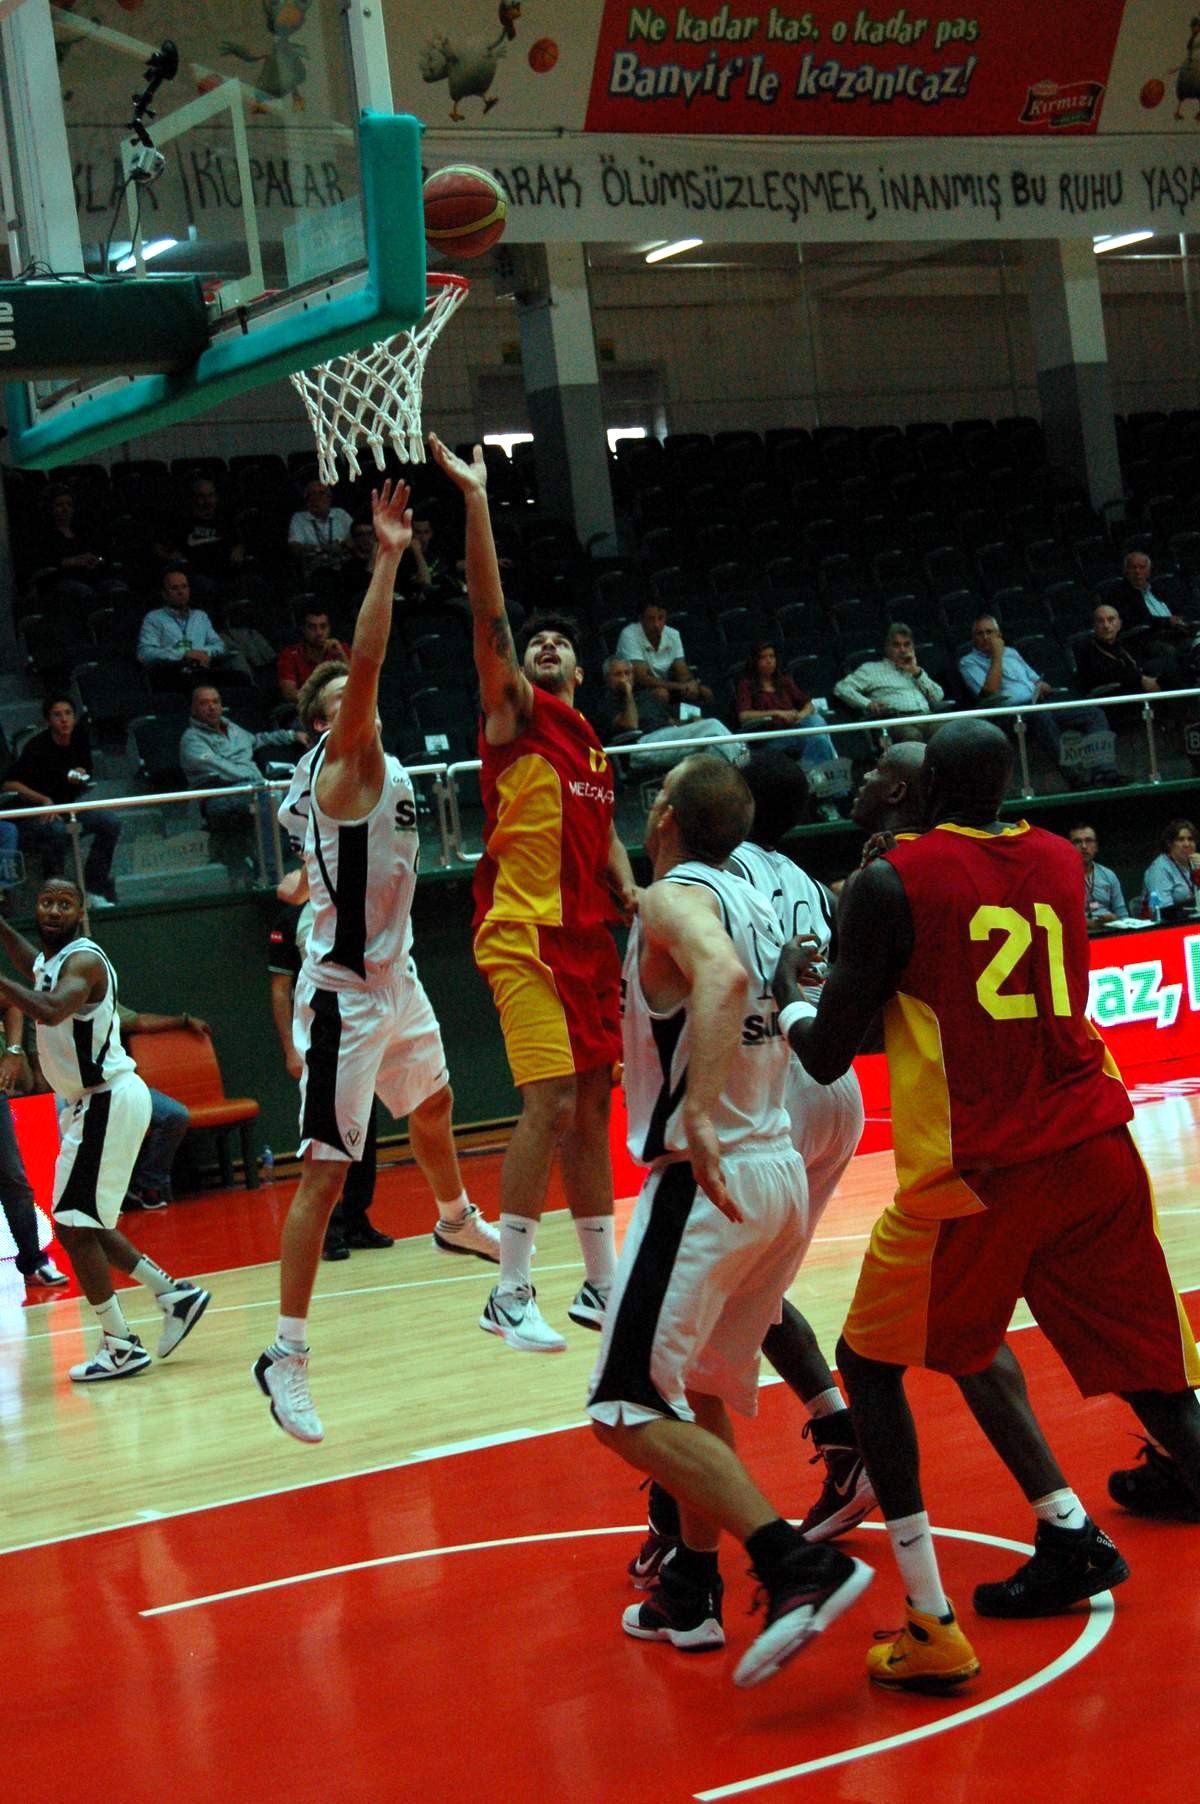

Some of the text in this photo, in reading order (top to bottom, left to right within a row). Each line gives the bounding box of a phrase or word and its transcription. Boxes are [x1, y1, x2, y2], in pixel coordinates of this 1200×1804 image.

[629, 6, 667, 41] Ne
[675, 4, 758, 42] kadar
[831, 20, 848, 42] o
[854, 8, 929, 45] kadar
[934, 17, 979, 49] pas
[609, 49, 780, 105] Banvit'le
[494, 162, 583, 209] ARAK
[1010, 170, 1047, 208] BU
[1057, 169, 1124, 214] RUHU
[968, 902, 1072, 1021] 21
[1085, 960, 1184, 1030] az,
